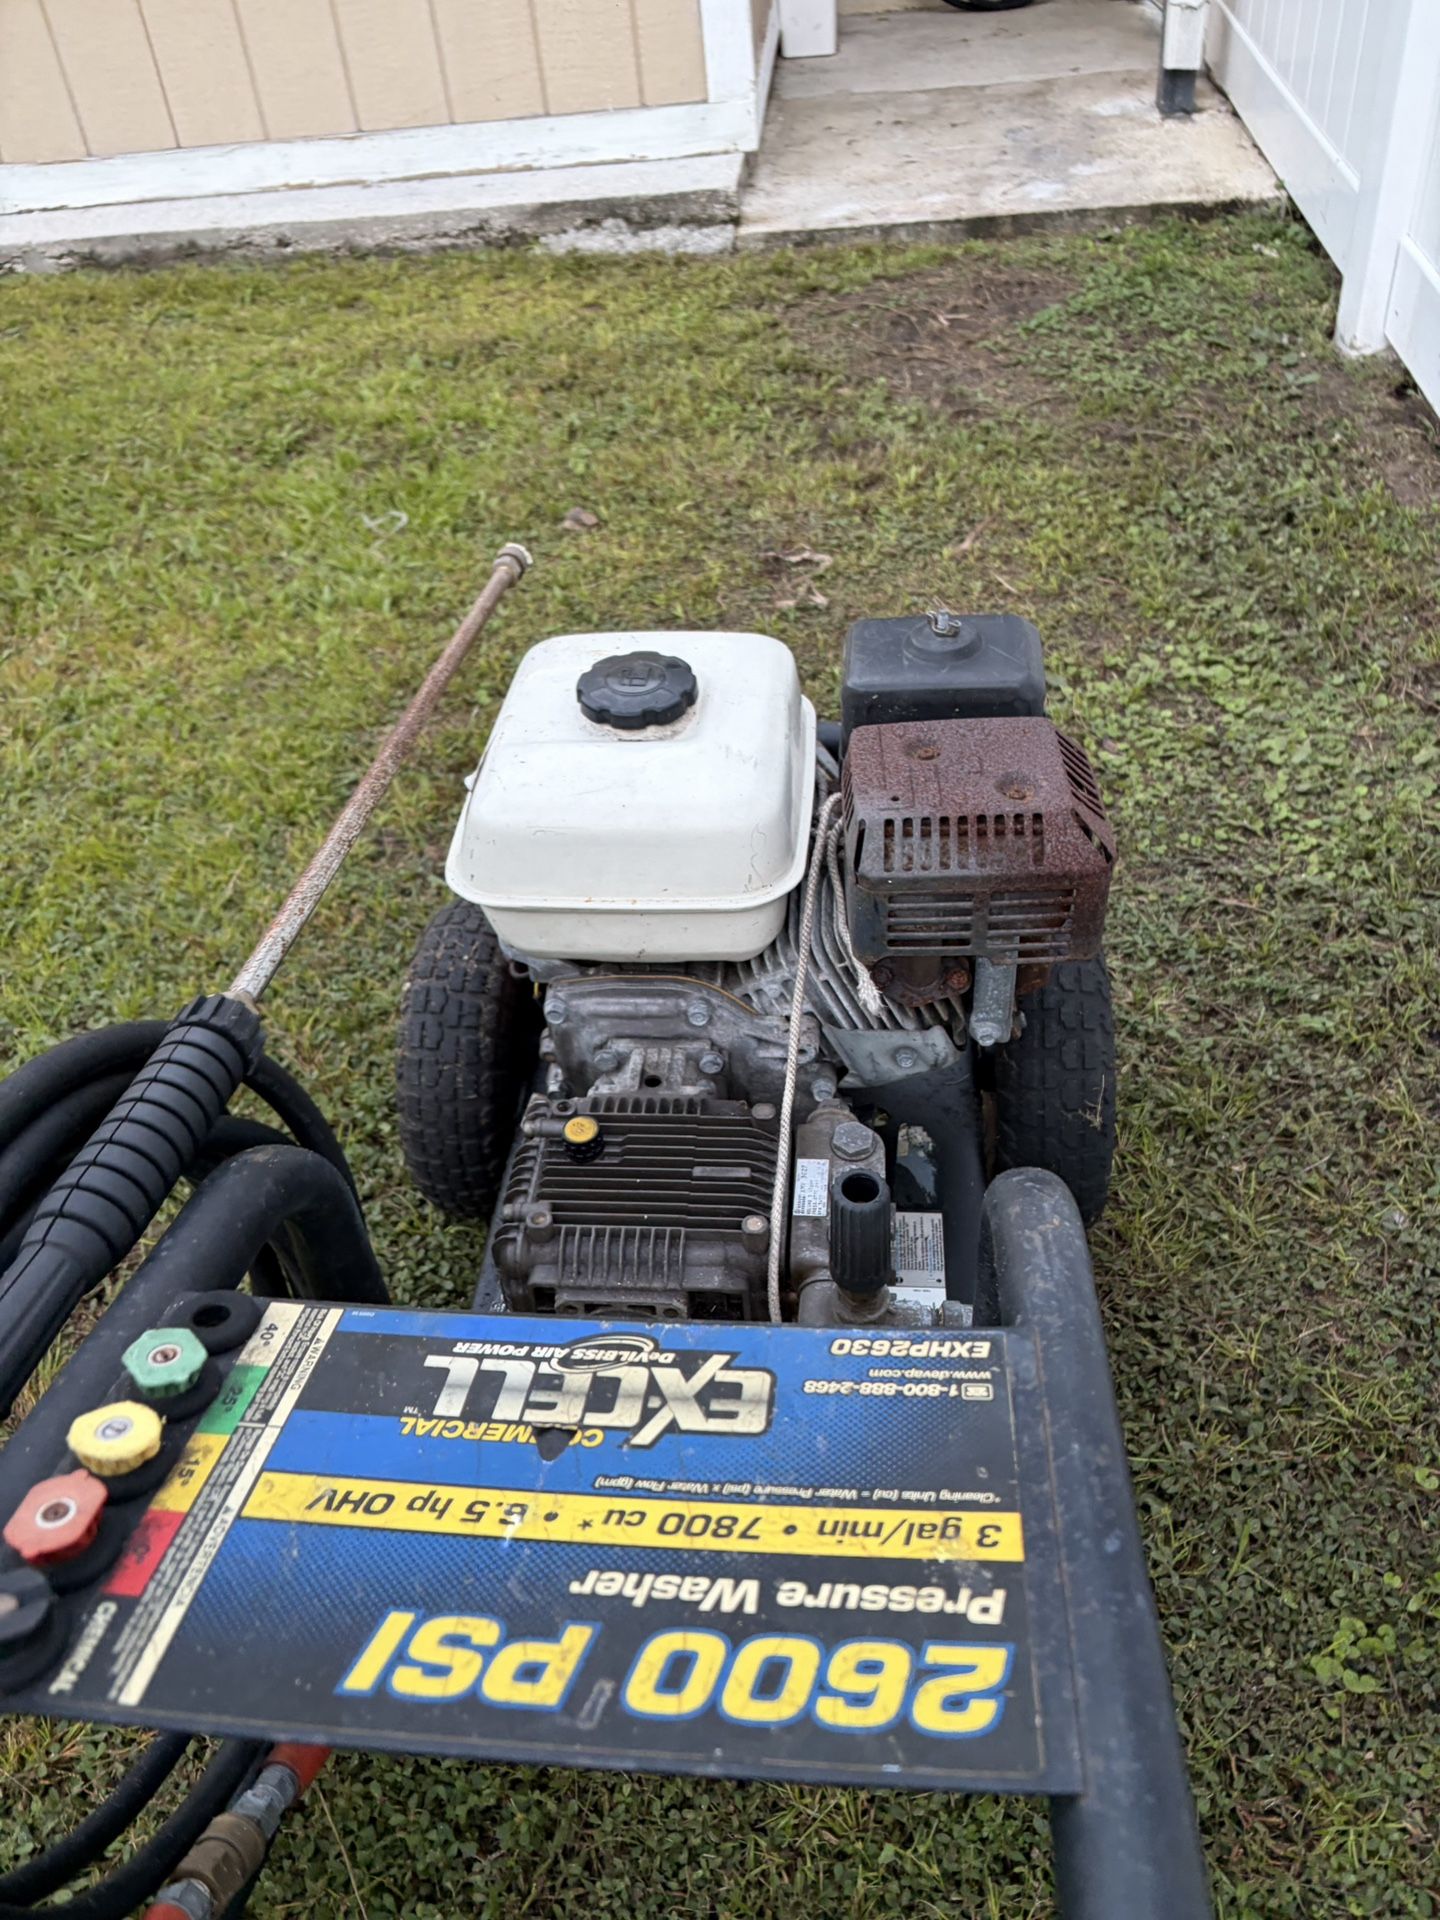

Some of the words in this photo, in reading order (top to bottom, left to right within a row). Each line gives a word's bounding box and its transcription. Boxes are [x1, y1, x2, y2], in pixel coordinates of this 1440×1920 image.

[453, 1341, 529, 1357] POWER
[532, 1345, 570, 1359] AIR
[569, 1347, 676, 1365] DeVILBISS
[830, 1338, 992, 1359] EXHP2630
[290, 1346, 323, 1391] WARNING
[869, 1367, 992, 1380] www.devap.com
[423, 1353, 772, 1448] EXCELL
[803, 1379, 960, 1398] 1-800-888-2468
[400, 1416, 605, 1448] CMERCIAL
[594, 1476, 634, 1490] (gpm)
[636, 1480, 666, 1492] Flow
[667, 1482, 709, 1494] Water
[753, 1484, 813, 1499] Pressure
[814, 1487, 858, 1500] Water
[901, 1487, 937, 1502] Units
[307, 1488, 396, 1515] OHV
[406, 1489, 454, 1519] hp
[460, 1501, 529, 1526] 6.5
[656, 1510, 763, 1540] 7800
[816, 1516, 963, 1547] gal/min
[975, 1524, 1003, 1548] 3
[176, 1515, 231, 1607] ADVERTENCIA
[569, 1569, 760, 1615] Washer
[776, 1580, 1007, 1625] Pressure
[49, 1600, 118, 1694] CHEMICAL
[333, 1605, 603, 1713] PSI
[620, 1626, 1016, 1740] 2600
